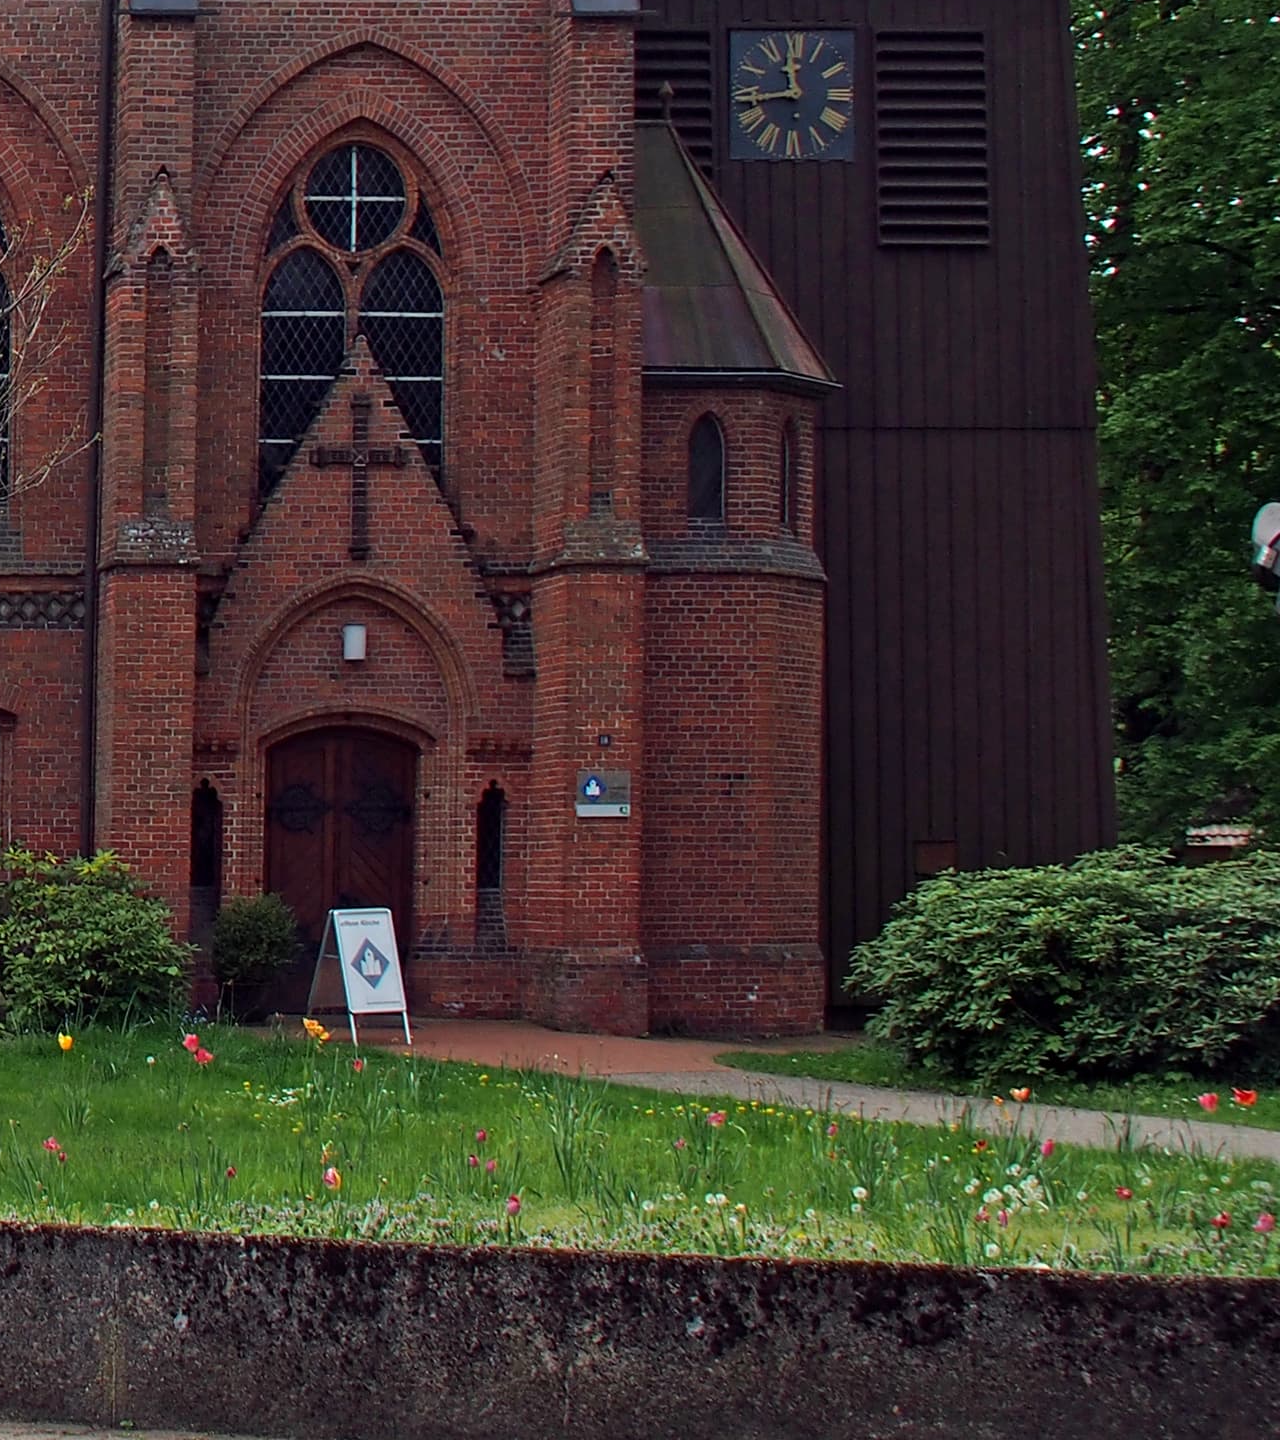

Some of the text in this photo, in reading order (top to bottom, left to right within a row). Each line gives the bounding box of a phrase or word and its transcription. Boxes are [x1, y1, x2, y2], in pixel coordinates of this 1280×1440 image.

[821, 61, 847, 79] II
[826, 88, 853, 101] III
[819, 106, 849, 133] IIII
